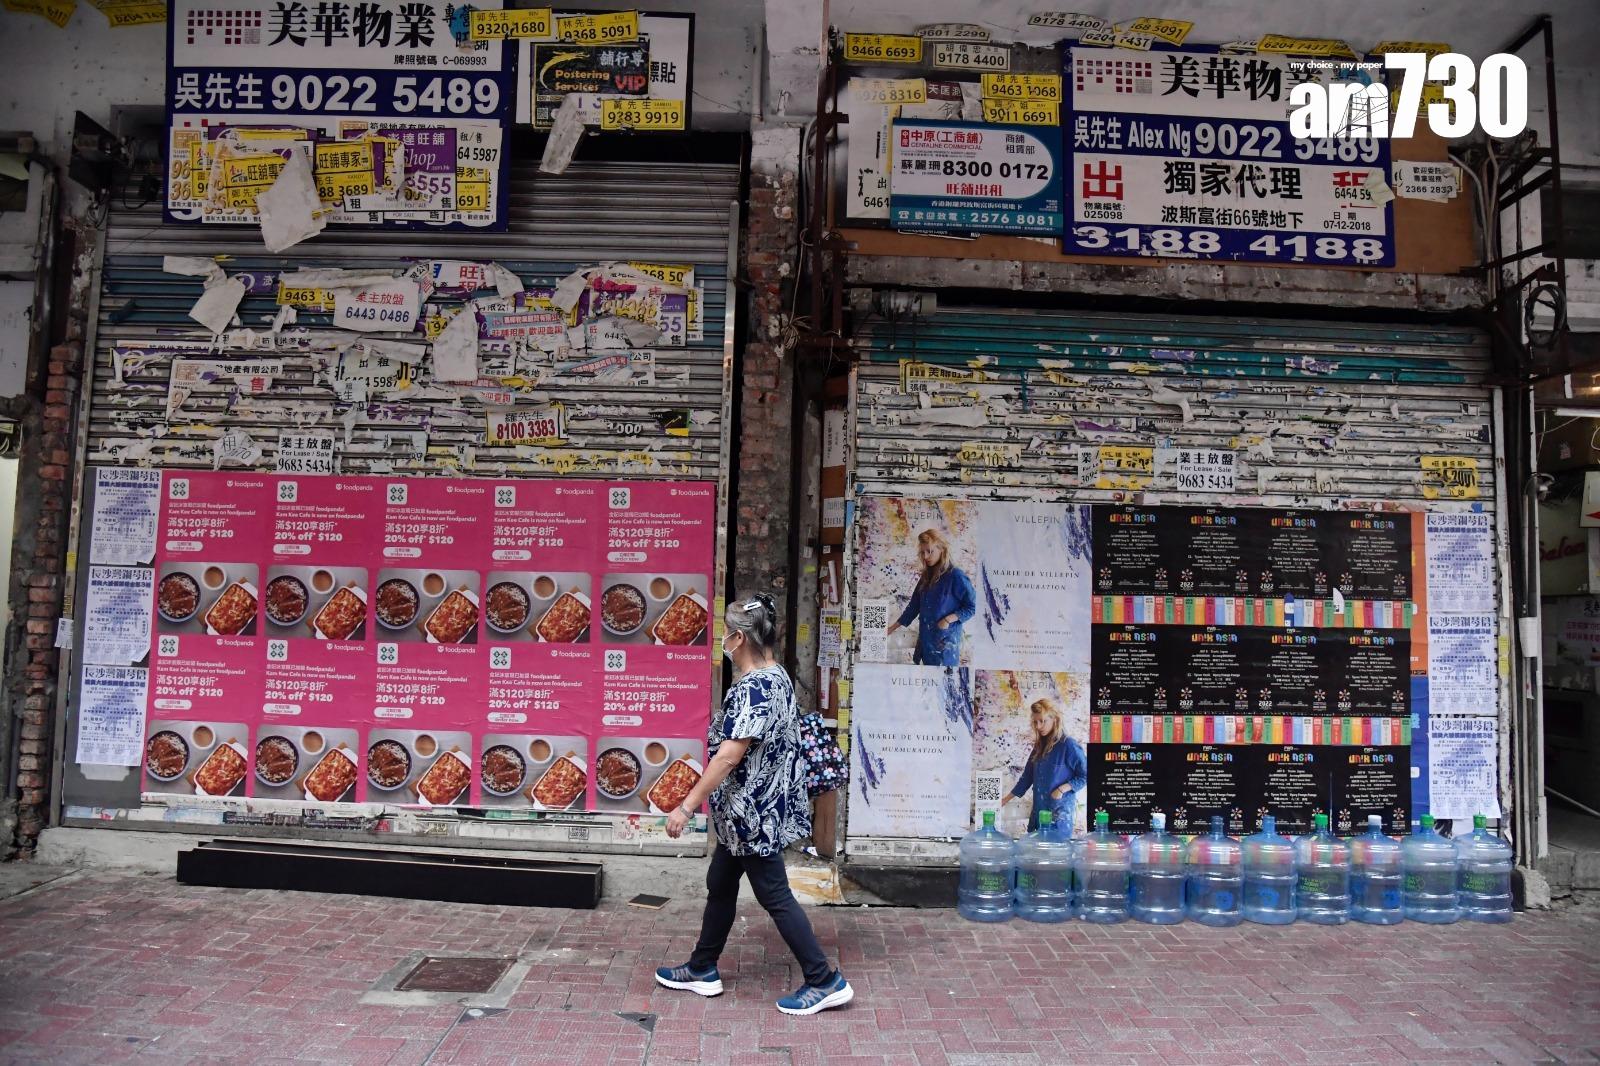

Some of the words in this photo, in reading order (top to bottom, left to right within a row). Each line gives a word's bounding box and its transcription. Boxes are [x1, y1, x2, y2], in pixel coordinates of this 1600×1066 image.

[268, 1, 437, 48] 美華物業
[477, 23, 509, 34] 9320
[513, 22, 545, 33] 1680
[1033, 16, 1064, 25] 9178
[1068, 19, 1100, 28] 4400
[601, 25, 632, 38] 5091
[1153, 24, 1183, 36] 5091
[1085, 33, 1116, 43] 6204
[852, 45, 882, 56] 9466
[885, 46, 915, 58] 6693
[394, 54, 437, 66] 牌照號碼
[443, 56, 487, 65] C-069993
[938, 53, 969, 64] 9178
[974, 54, 1004, 66] 4400
[555, 70, 610, 80] Postering
[555, 82, 600, 91] Services
[614, 74, 647, 91] VIP
[174, 73, 264, 110] 吳先生
[271, 74, 377, 112] 9022
[393, 77, 500, 115] 5489
[890, 88, 921, 101] 8316
[991, 84, 1022, 96] 9463
[1027, 85, 1057, 97] 1068
[645, 112, 679, 124] 9919
[1023, 110, 1053, 122] 6691
[911, 130, 983, 145] 中原(工商舖)
[1005, 134, 1025, 144] 商舖
[1074, 116, 1123, 149] 吳先生
[1127, 121, 1164, 149] Alex
[1169, 123, 1191, 156] Ng
[1195, 123, 1282, 158] 9022
[473, 147, 498, 162] 5987
[943, 160, 992, 177] 8300
[1000, 162, 1049, 180] 0172
[1083, 161, 1123, 200] 出
[1164, 161, 1302, 200] 獨家代理
[339, 185, 369, 197] 3689
[946, 183, 1002, 196] 旺舖出租
[351, 198, 361, 209] 租
[441, 197, 452, 209] 售
[970, 213, 1010, 224] 2576
[1017, 214, 1053, 225] 8081
[1084, 210, 1123, 220] 025098
[1161, 205, 1303, 229] 波斯富街66號地下
[1323, 219, 1371, 231] 07-12-2018
[1074, 226, 1222, 253] 3188
[1249, 234, 1384, 260] 4188
[285, 291, 315, 301] 9463
[346, 306, 376, 321] 6443
[380, 308, 410, 323] 0486
[250, 377, 265, 391] 售
[496, 421, 524, 440] 8100
[281, 437, 332, 449] 業主放盤
[1179, 452, 1234, 466] 業主放盤
[278, 458, 303, 472] 9683
[305, 459, 331, 473] 5434
[234, 480, 263, 488] foodpanda
[1178, 473, 1205, 488] 9683
[1207, 474, 1233, 489] 5434
[1014, 515, 1060, 524] VILLEPIN
[168, 528, 188, 537] 20%
[209, 529, 234, 538] $120
[274, 532, 296, 540] 20%
[318, 533, 343, 542] $120
[384, 534, 406, 543] 20%
[429, 535, 454, 544] $120
[493, 537, 515, 546] 20%
[538, 538, 564, 547] $120
[608, 539, 631, 548] 20%
[654, 540, 680, 548] $120
[891, 677, 938, 687] VILLEPIN
[156, 686, 177, 695] 20%
[199, 688, 223, 697] $120
[265, 691, 286, 700] 20%
[308, 693, 333, 702] $120
[375, 695, 397, 703] 20%
[420, 696, 445, 705] $120
[488, 700, 511, 708] 20%
[534, 701, 560, 710] $120
[603, 702, 626, 711] 20%
[649, 703, 675, 712] $120
[868, 732, 897, 740] MARIE
[916, 734, 957, 742] VILLEPIN
